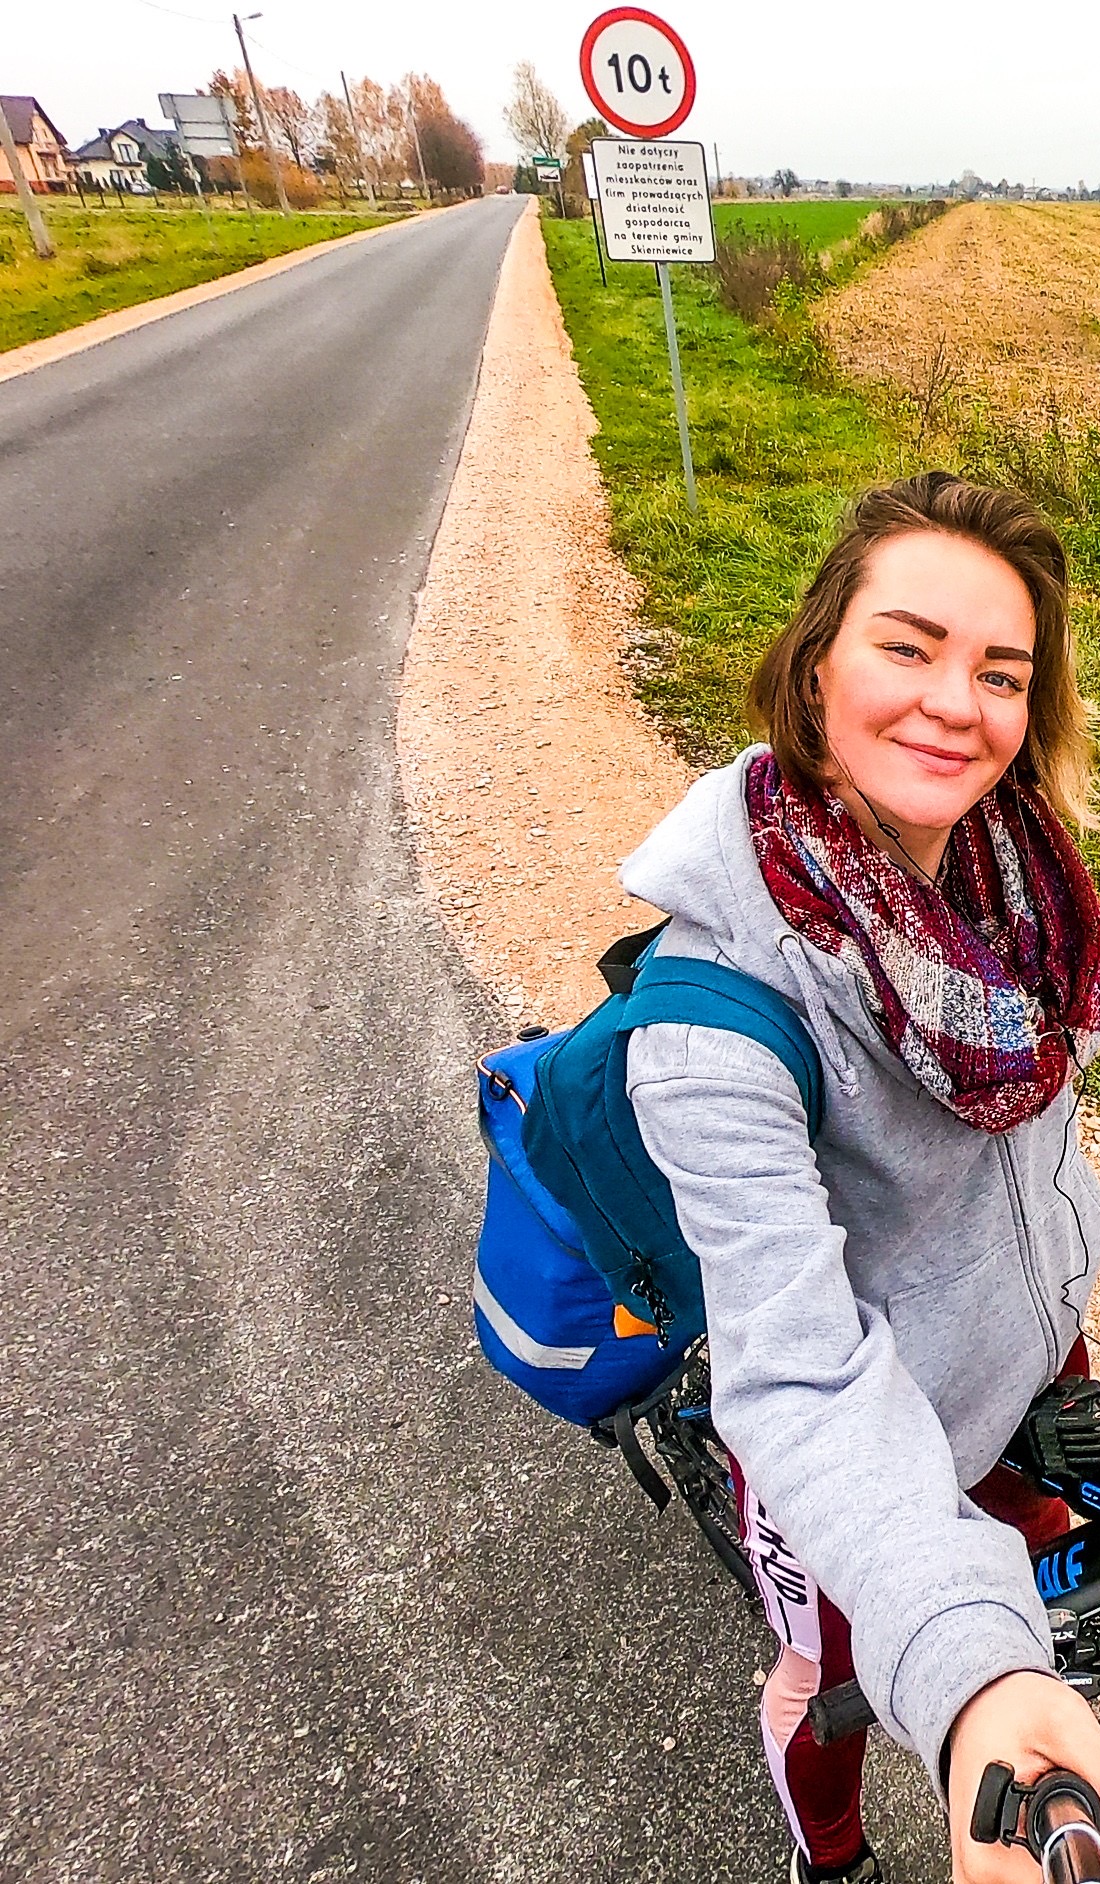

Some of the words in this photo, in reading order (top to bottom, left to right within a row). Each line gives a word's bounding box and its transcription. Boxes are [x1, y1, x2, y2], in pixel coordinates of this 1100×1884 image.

[607, 53, 652, 94] 10
[658, 65, 672, 94] t
[618, 144, 636, 155] Nie
[640, 146, 679, 159] dotyczy
[616, 161, 684, 172] zaopatrzenia
[606, 174, 673, 186] mieszkańców
[605, 188, 625, 198] firm
[632, 190, 704, 202] prowadzących
[626, 203, 685, 214] działalność
[632, 231, 668, 241] terenie
[674, 232, 703, 244] gminy
[631, 244, 693, 255] Skierniewice
